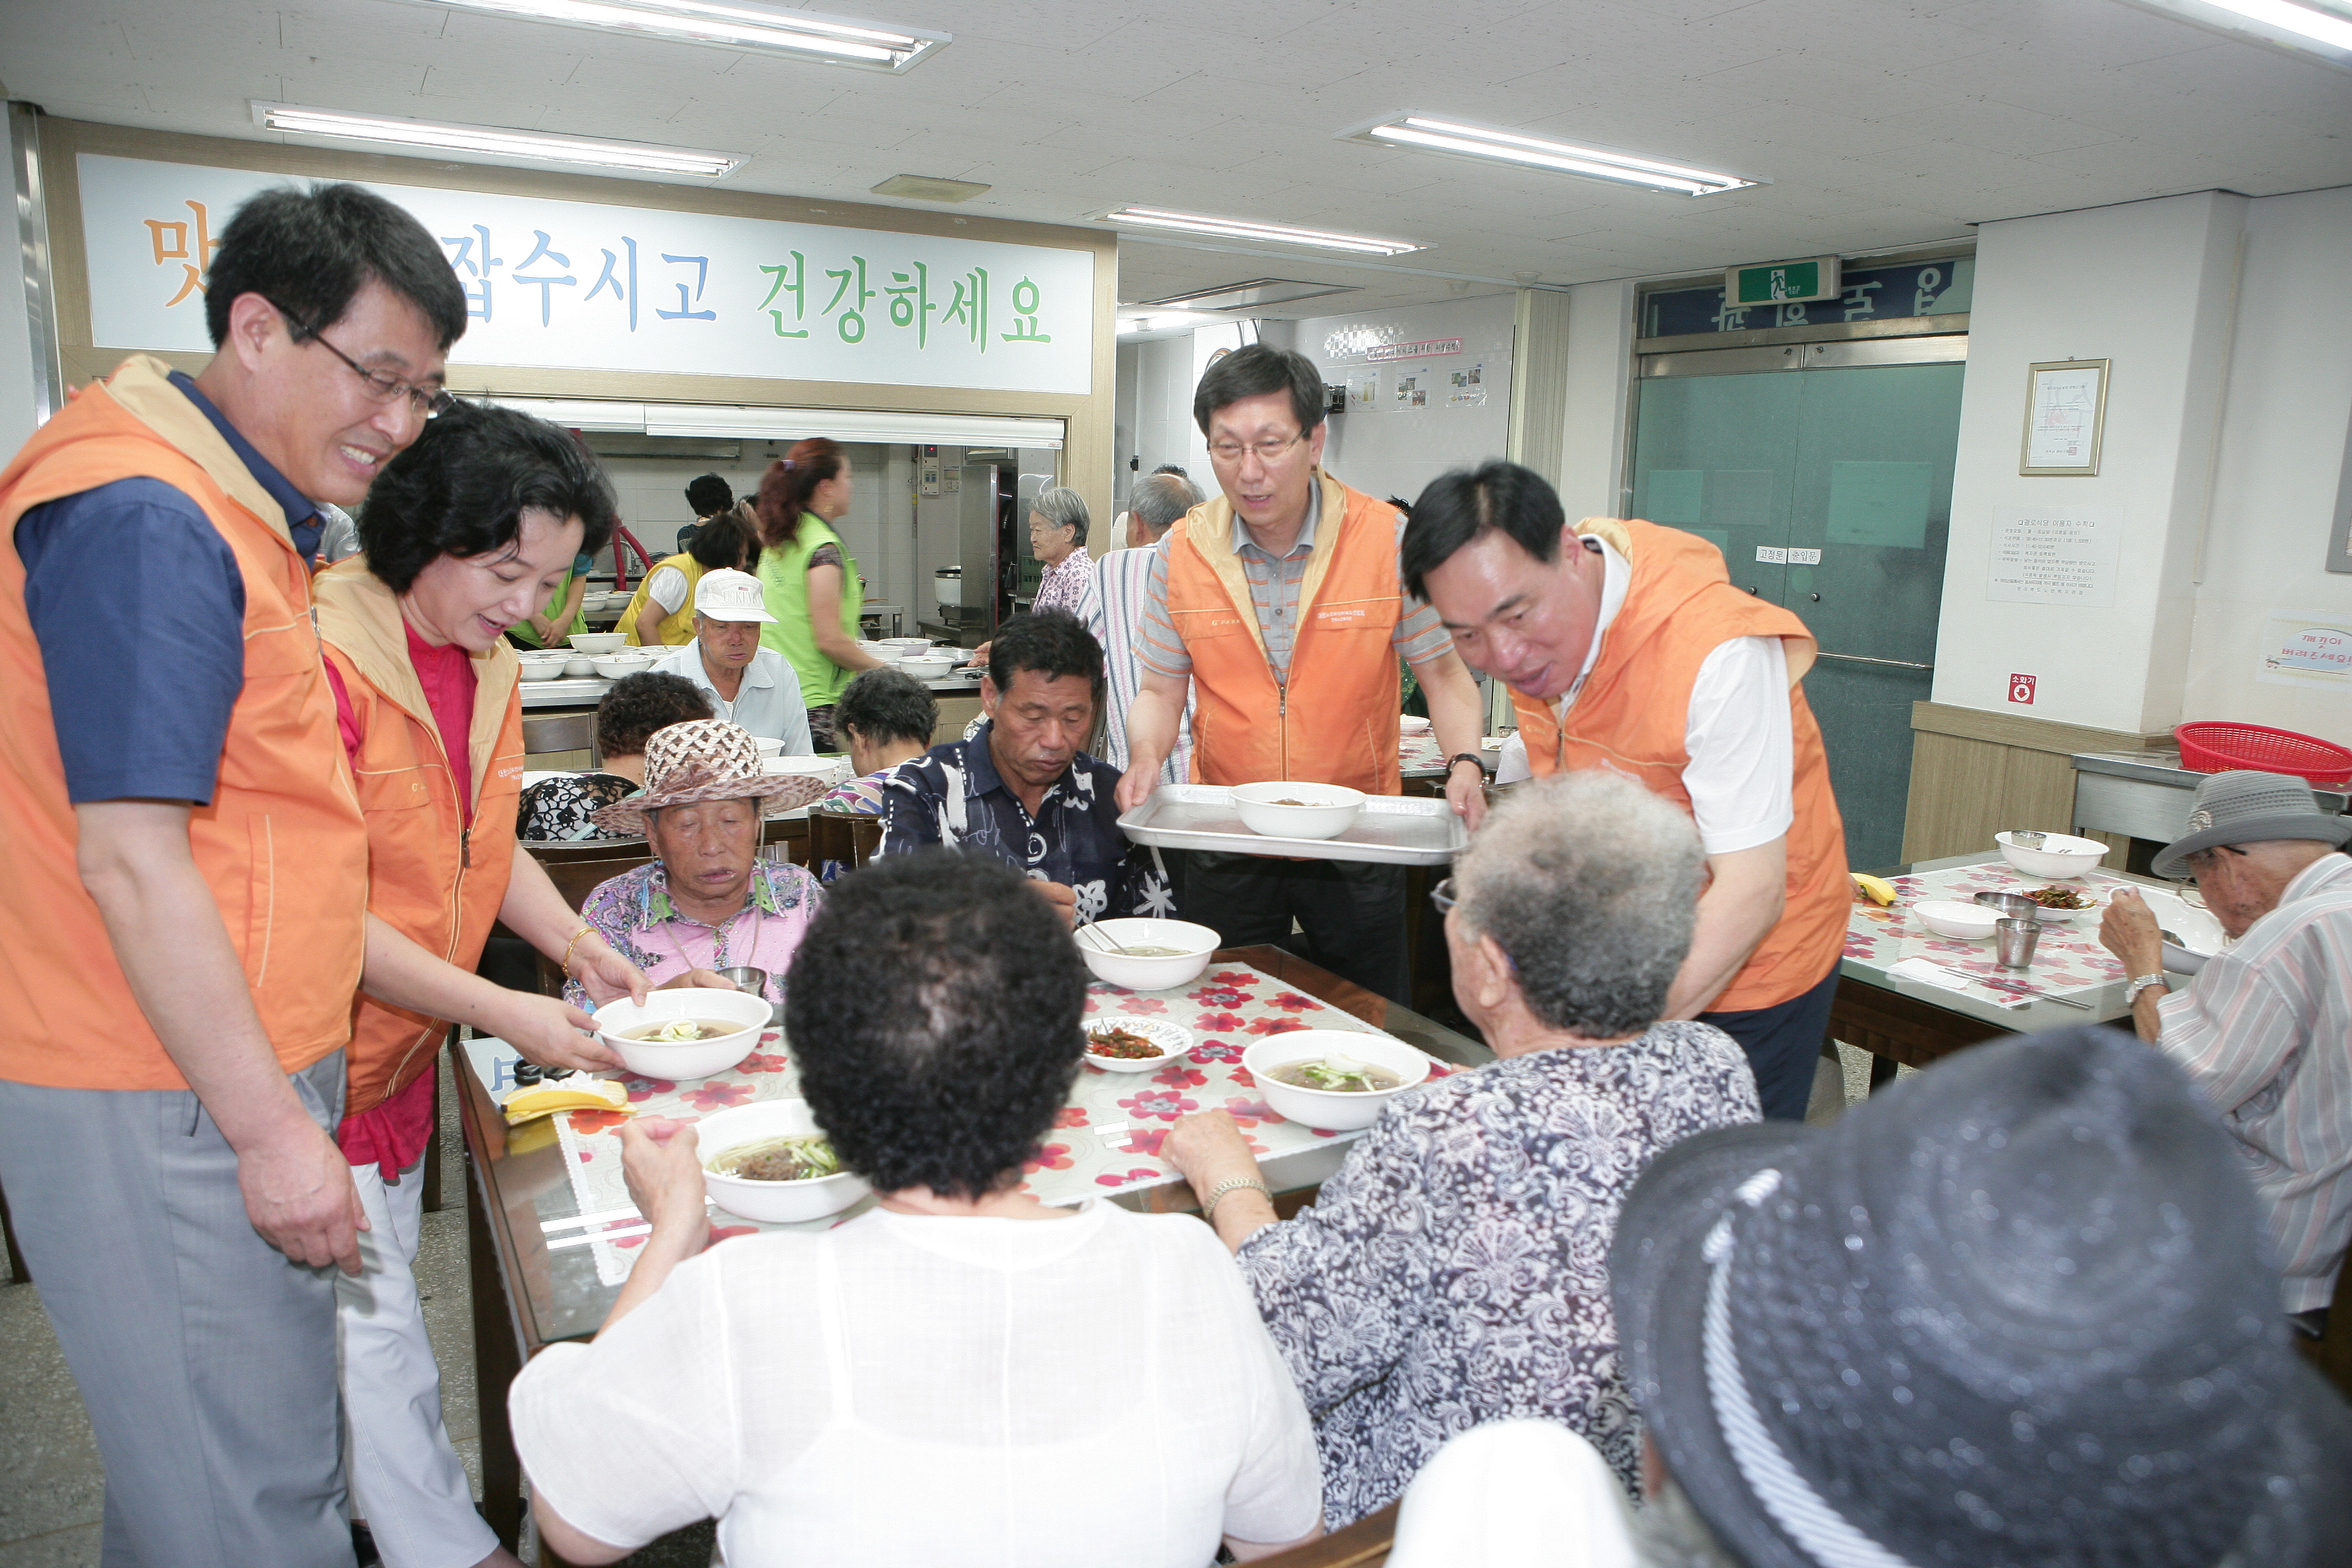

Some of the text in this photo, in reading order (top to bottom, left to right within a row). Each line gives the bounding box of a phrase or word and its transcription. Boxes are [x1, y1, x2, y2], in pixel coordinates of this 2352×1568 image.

[441, 224, 717, 332] 잡수시고
[757, 250, 1052, 354] 건강하세요
[1759, 549, 1817, 562] 고정문 출입문
[2301, 635, 2341, 649] 깨끗이
[2011, 676, 2034, 685] 소화기
